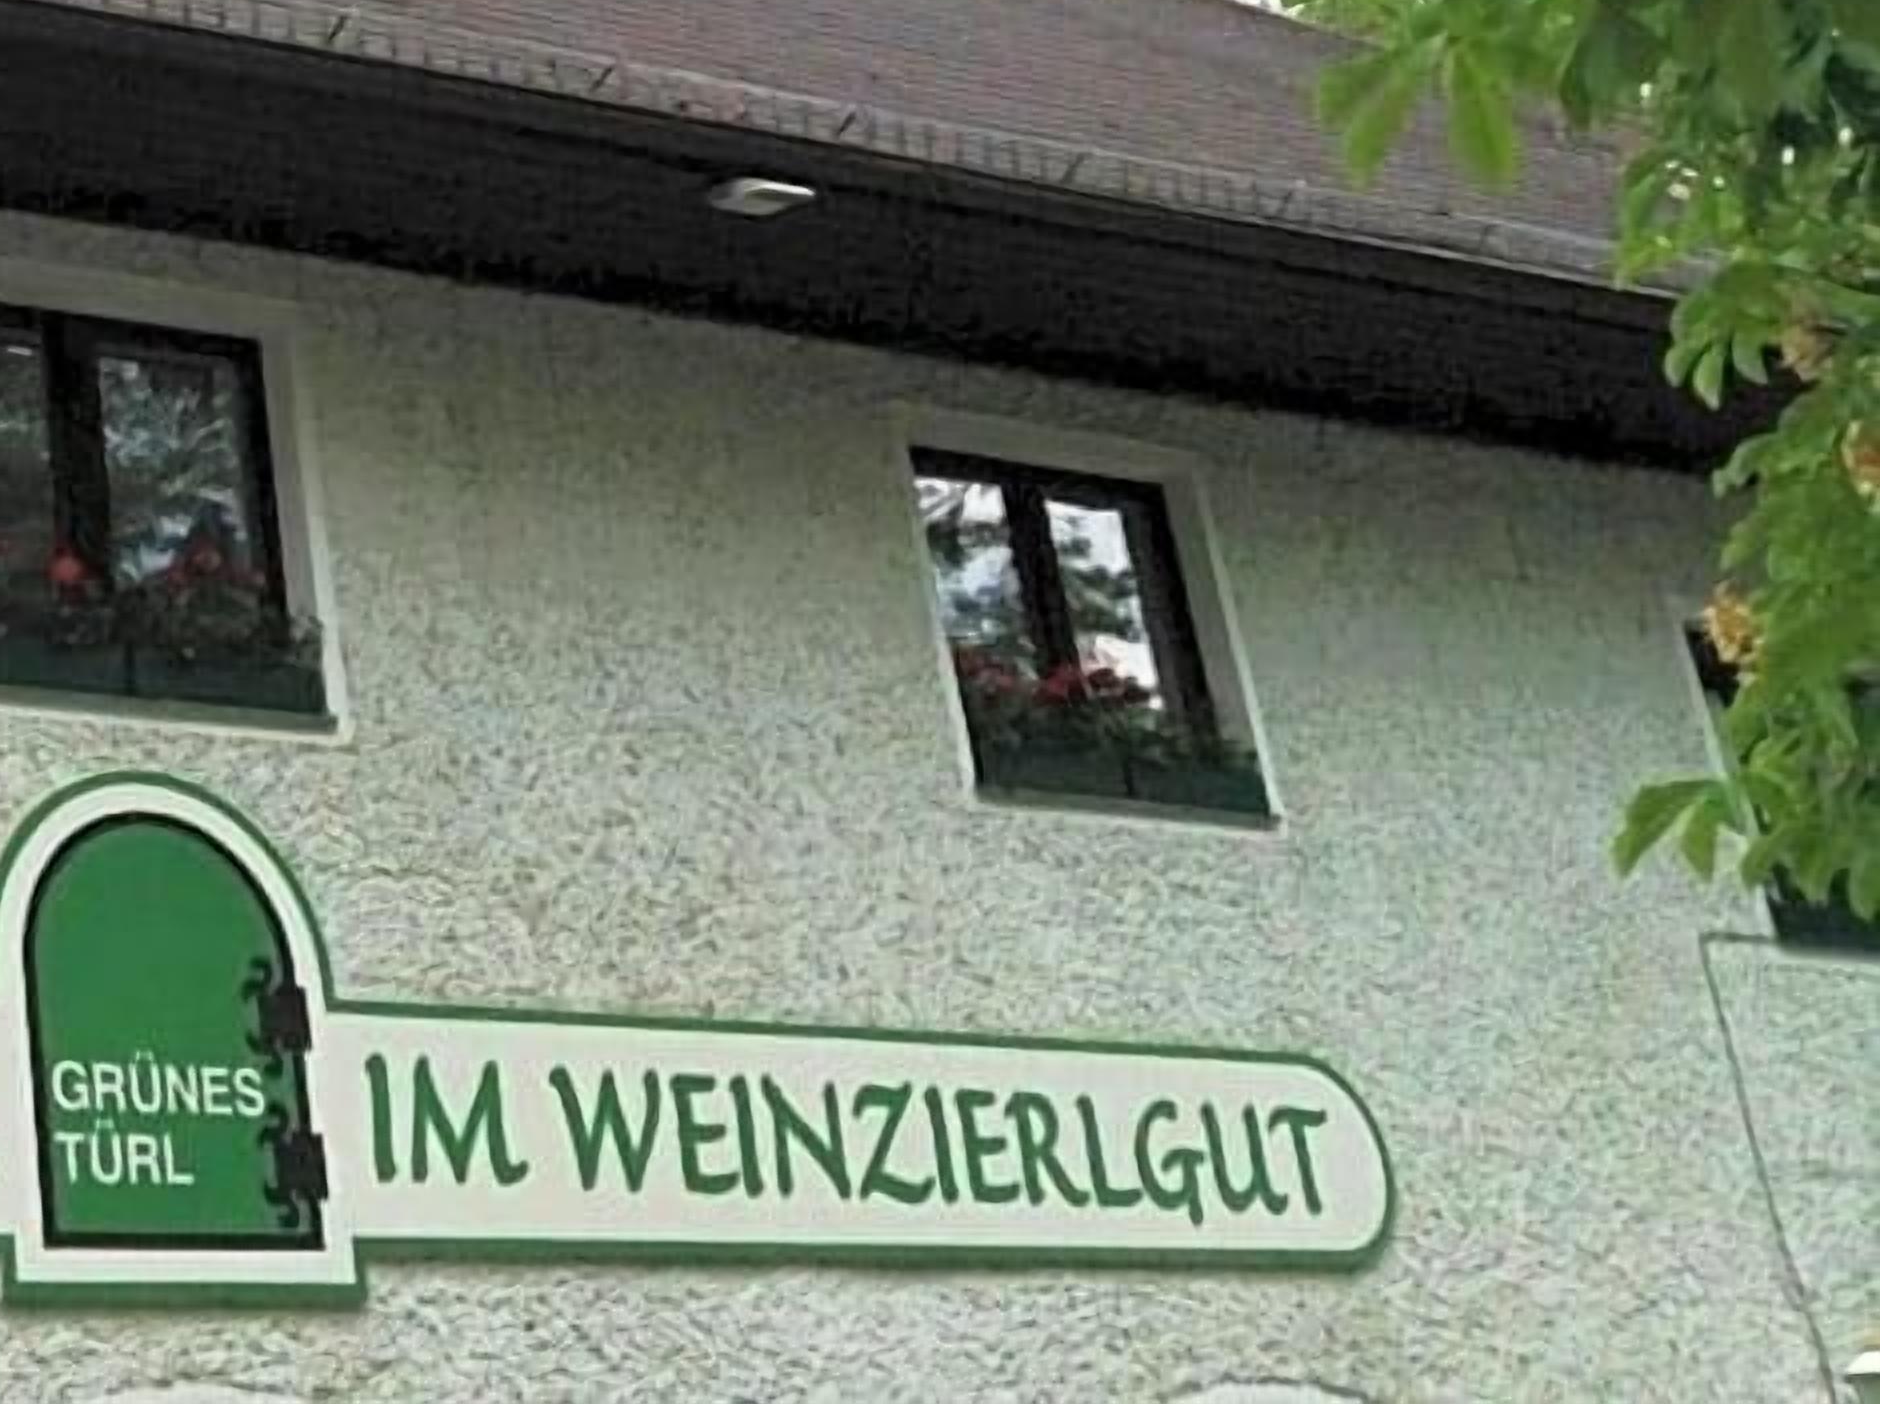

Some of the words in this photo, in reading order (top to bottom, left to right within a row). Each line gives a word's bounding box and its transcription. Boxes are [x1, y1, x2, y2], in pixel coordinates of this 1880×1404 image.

[51, 1049, 266, 1117] GRÜNES
[54, 1117, 196, 1186] TÜRL
[365, 1053, 528, 1186] IM
[550, 1064, 1328, 1227] WEINZIERLGUT
